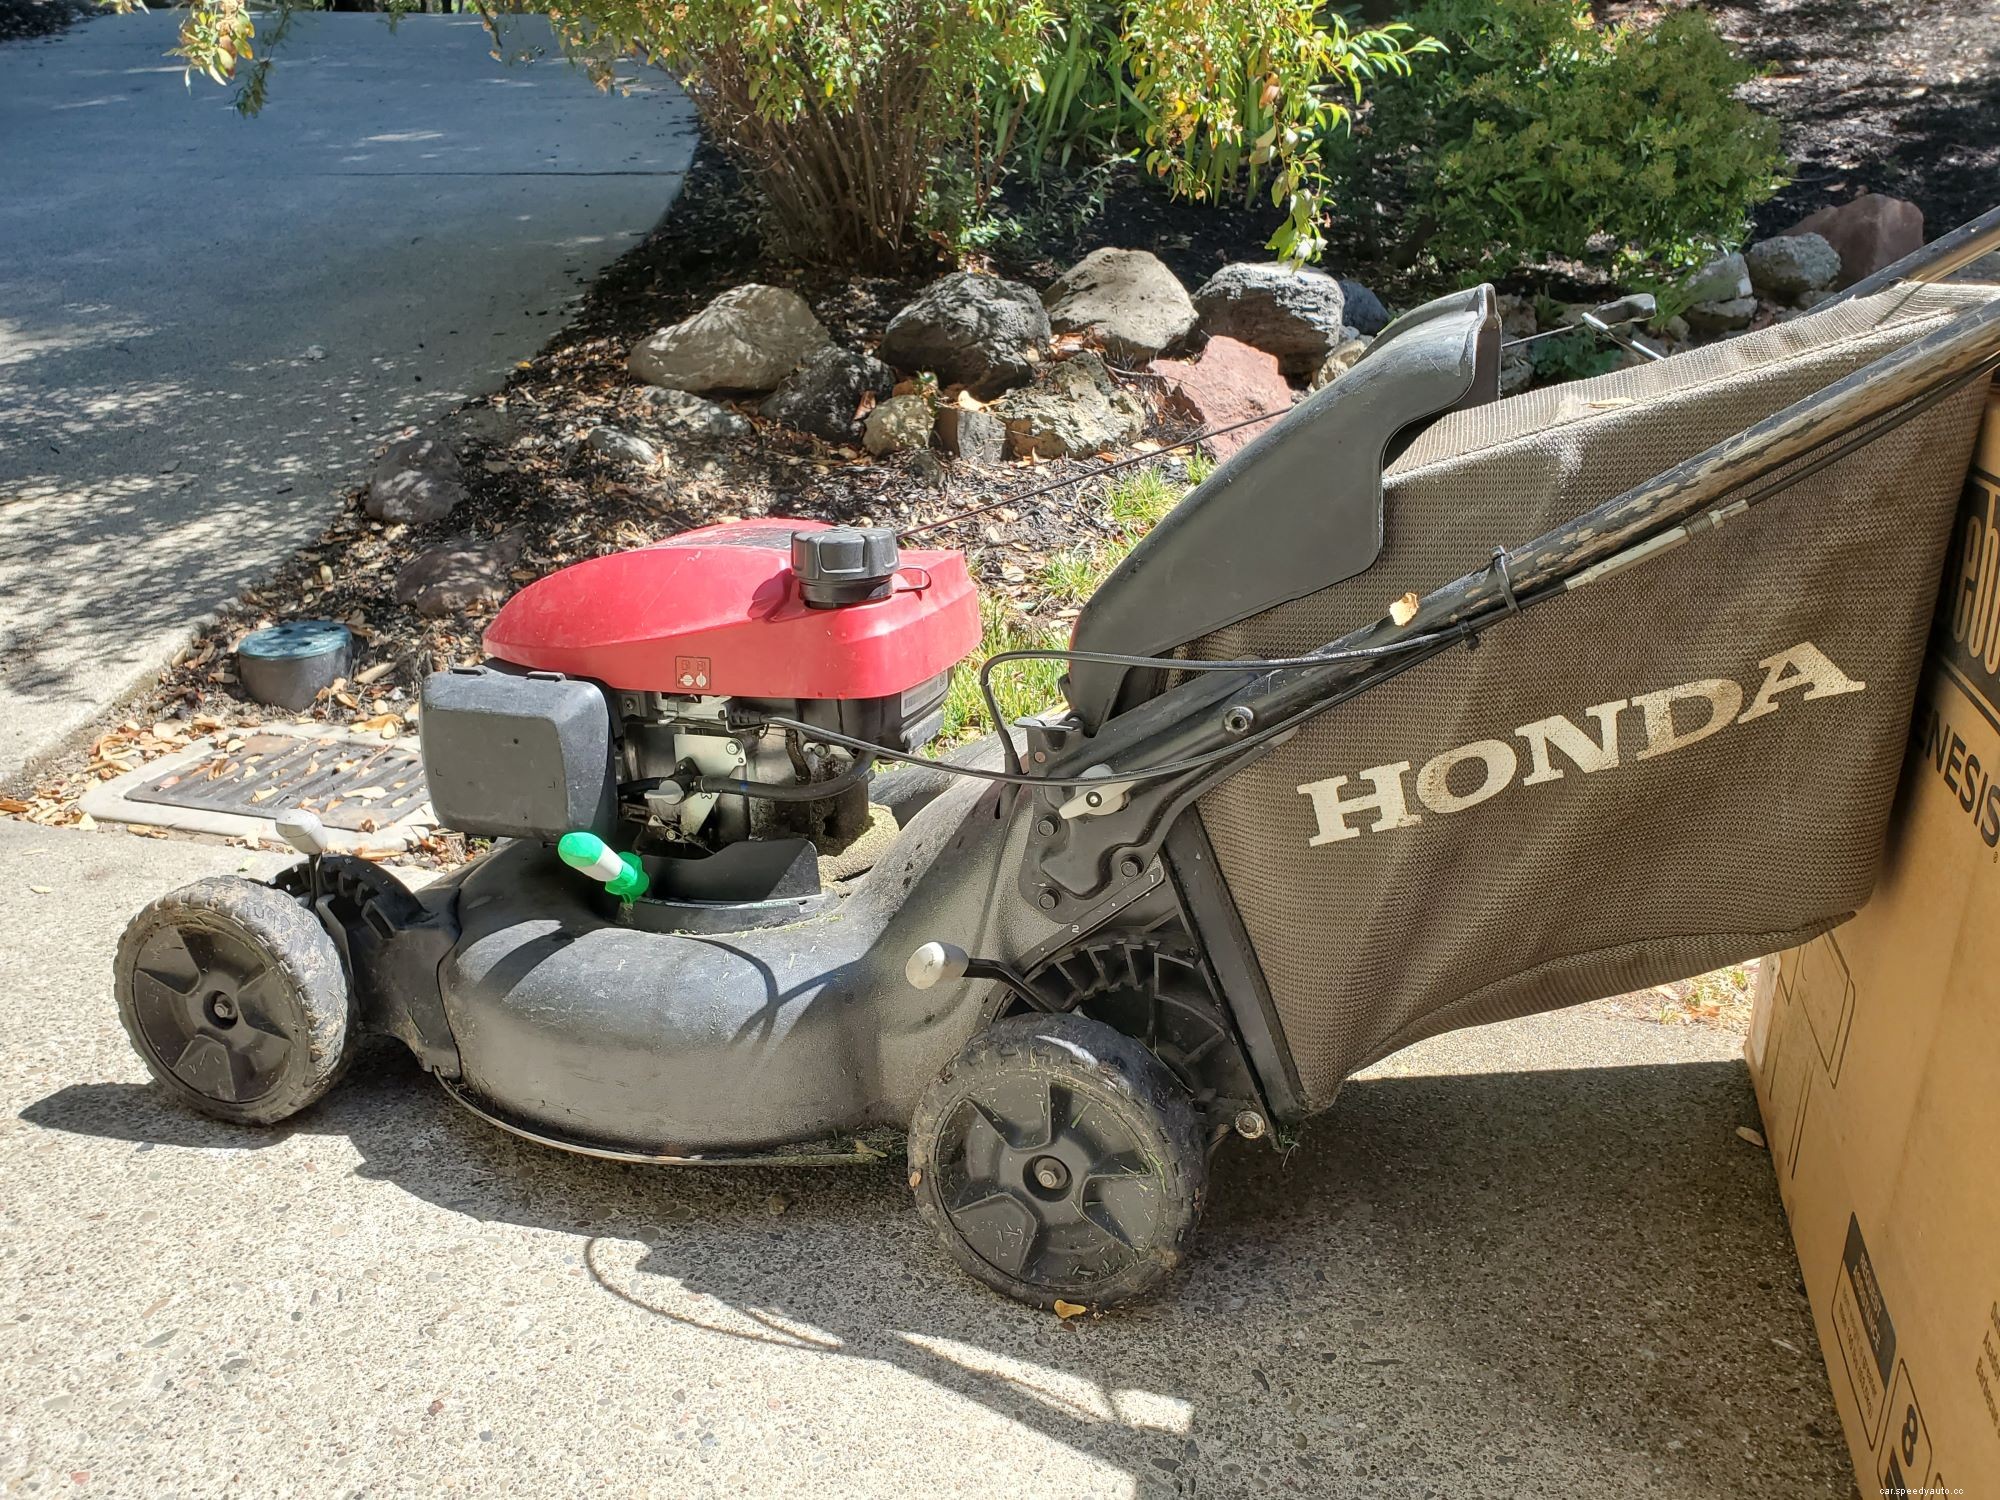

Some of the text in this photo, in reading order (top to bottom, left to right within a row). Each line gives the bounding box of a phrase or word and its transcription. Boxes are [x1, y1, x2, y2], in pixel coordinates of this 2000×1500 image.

[1297, 641, 1866, 847] HONDA
[1072, 924, 1080, 933] 2
[1902, 1404, 1918, 1468] 8
